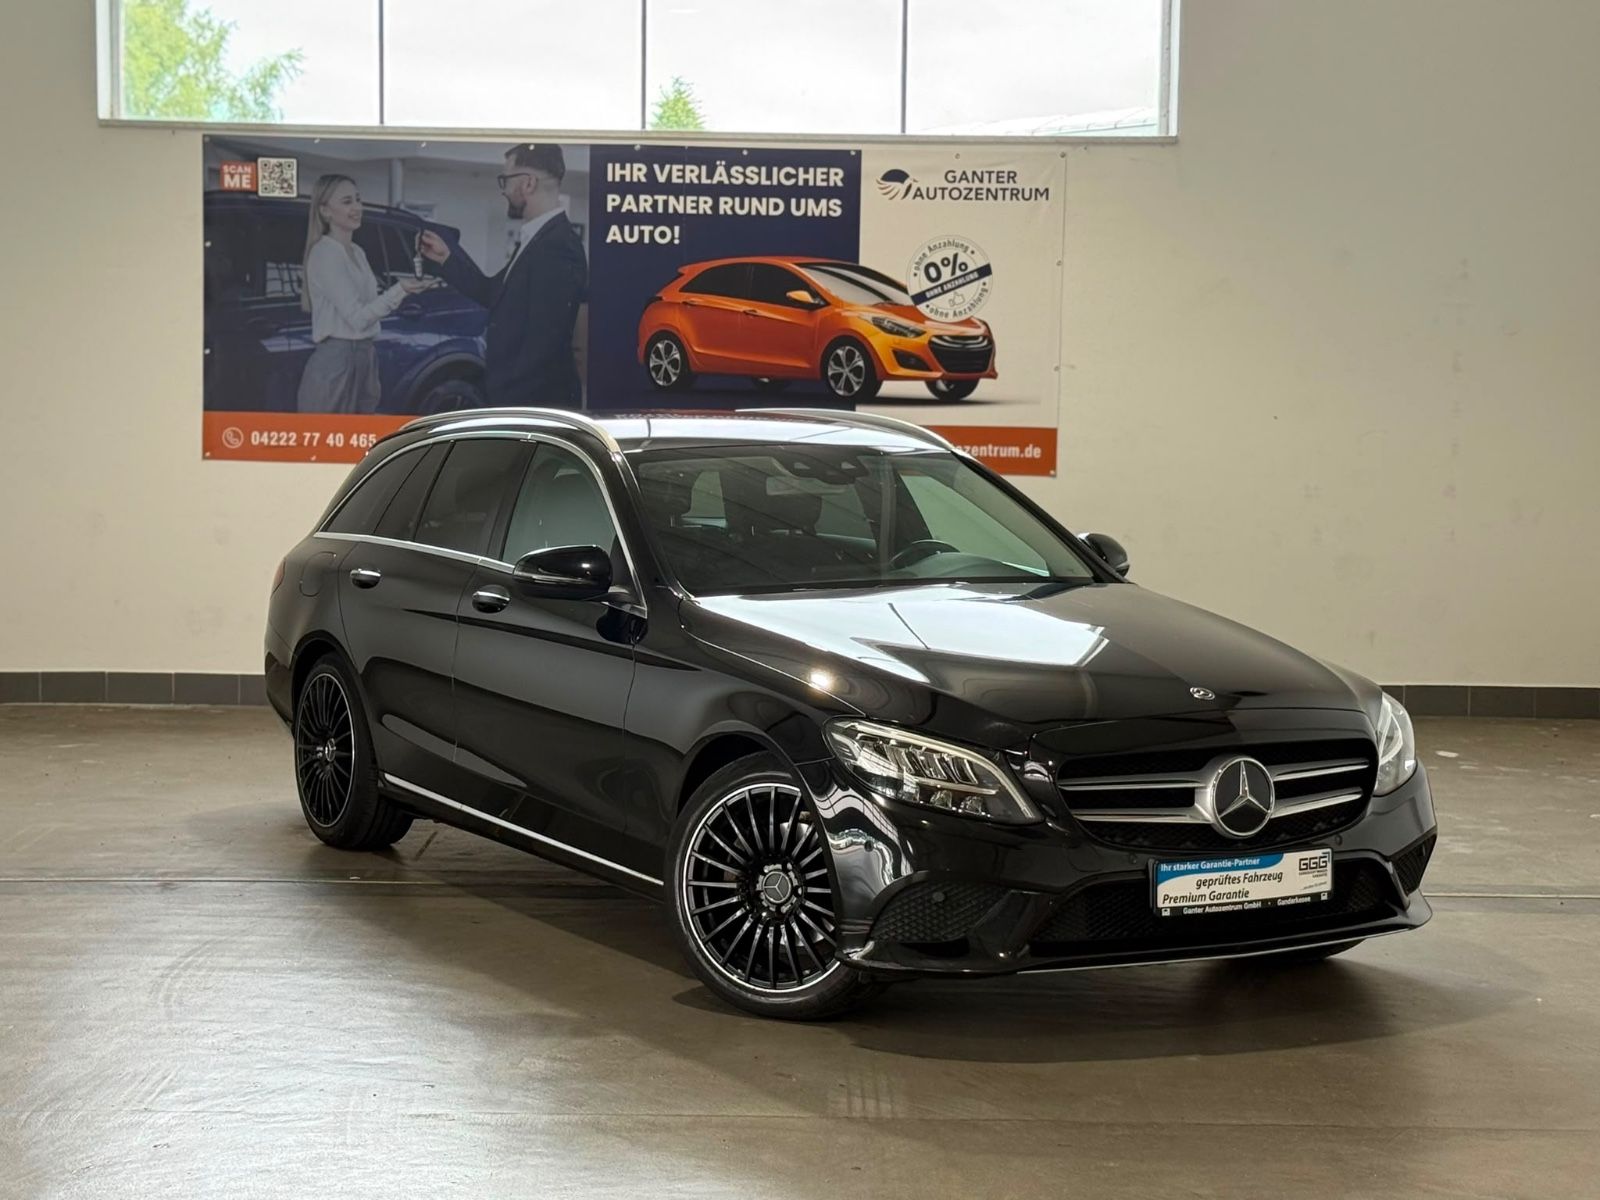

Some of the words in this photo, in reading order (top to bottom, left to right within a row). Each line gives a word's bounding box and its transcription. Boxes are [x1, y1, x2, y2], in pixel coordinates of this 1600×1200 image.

[223, 164, 252, 174] SCAN
[607, 163, 647, 182] IHR
[653, 160, 844, 187] VERLÄSSLICHER
[223, 174, 252, 188] ME
[944, 170, 1018, 184] GANTER
[912, 187, 1049, 201] AUTOZENTRUM
[606, 194, 713, 215] PARTNER
[718, 197, 784, 216] RUND
[790, 198, 842, 217] UMS
[606, 225, 680, 244] AUTO!
[927, 239, 970, 253] Anzahlung
[924, 252, 969, 283] 0%
[929, 307, 949, 318] ohne
[250, 431, 297, 446] 04222
[303, 432, 321, 447] 77
[326, 433, 344, 448] 40
[350, 434, 376, 448] 465
[1160, 863, 1172, 872] Ihr
[1173, 861, 1199, 871] starker
[1200, 858, 1260, 869] Garantie-Partner
[1299, 856, 1328, 871] GGG
[1196, 874, 1241, 889] geprüftes
[1243, 871, 1283, 884] Fahrzeug
[1162, 892, 1207, 904] Premium
[1209, 888, 1250, 901] Garantie
